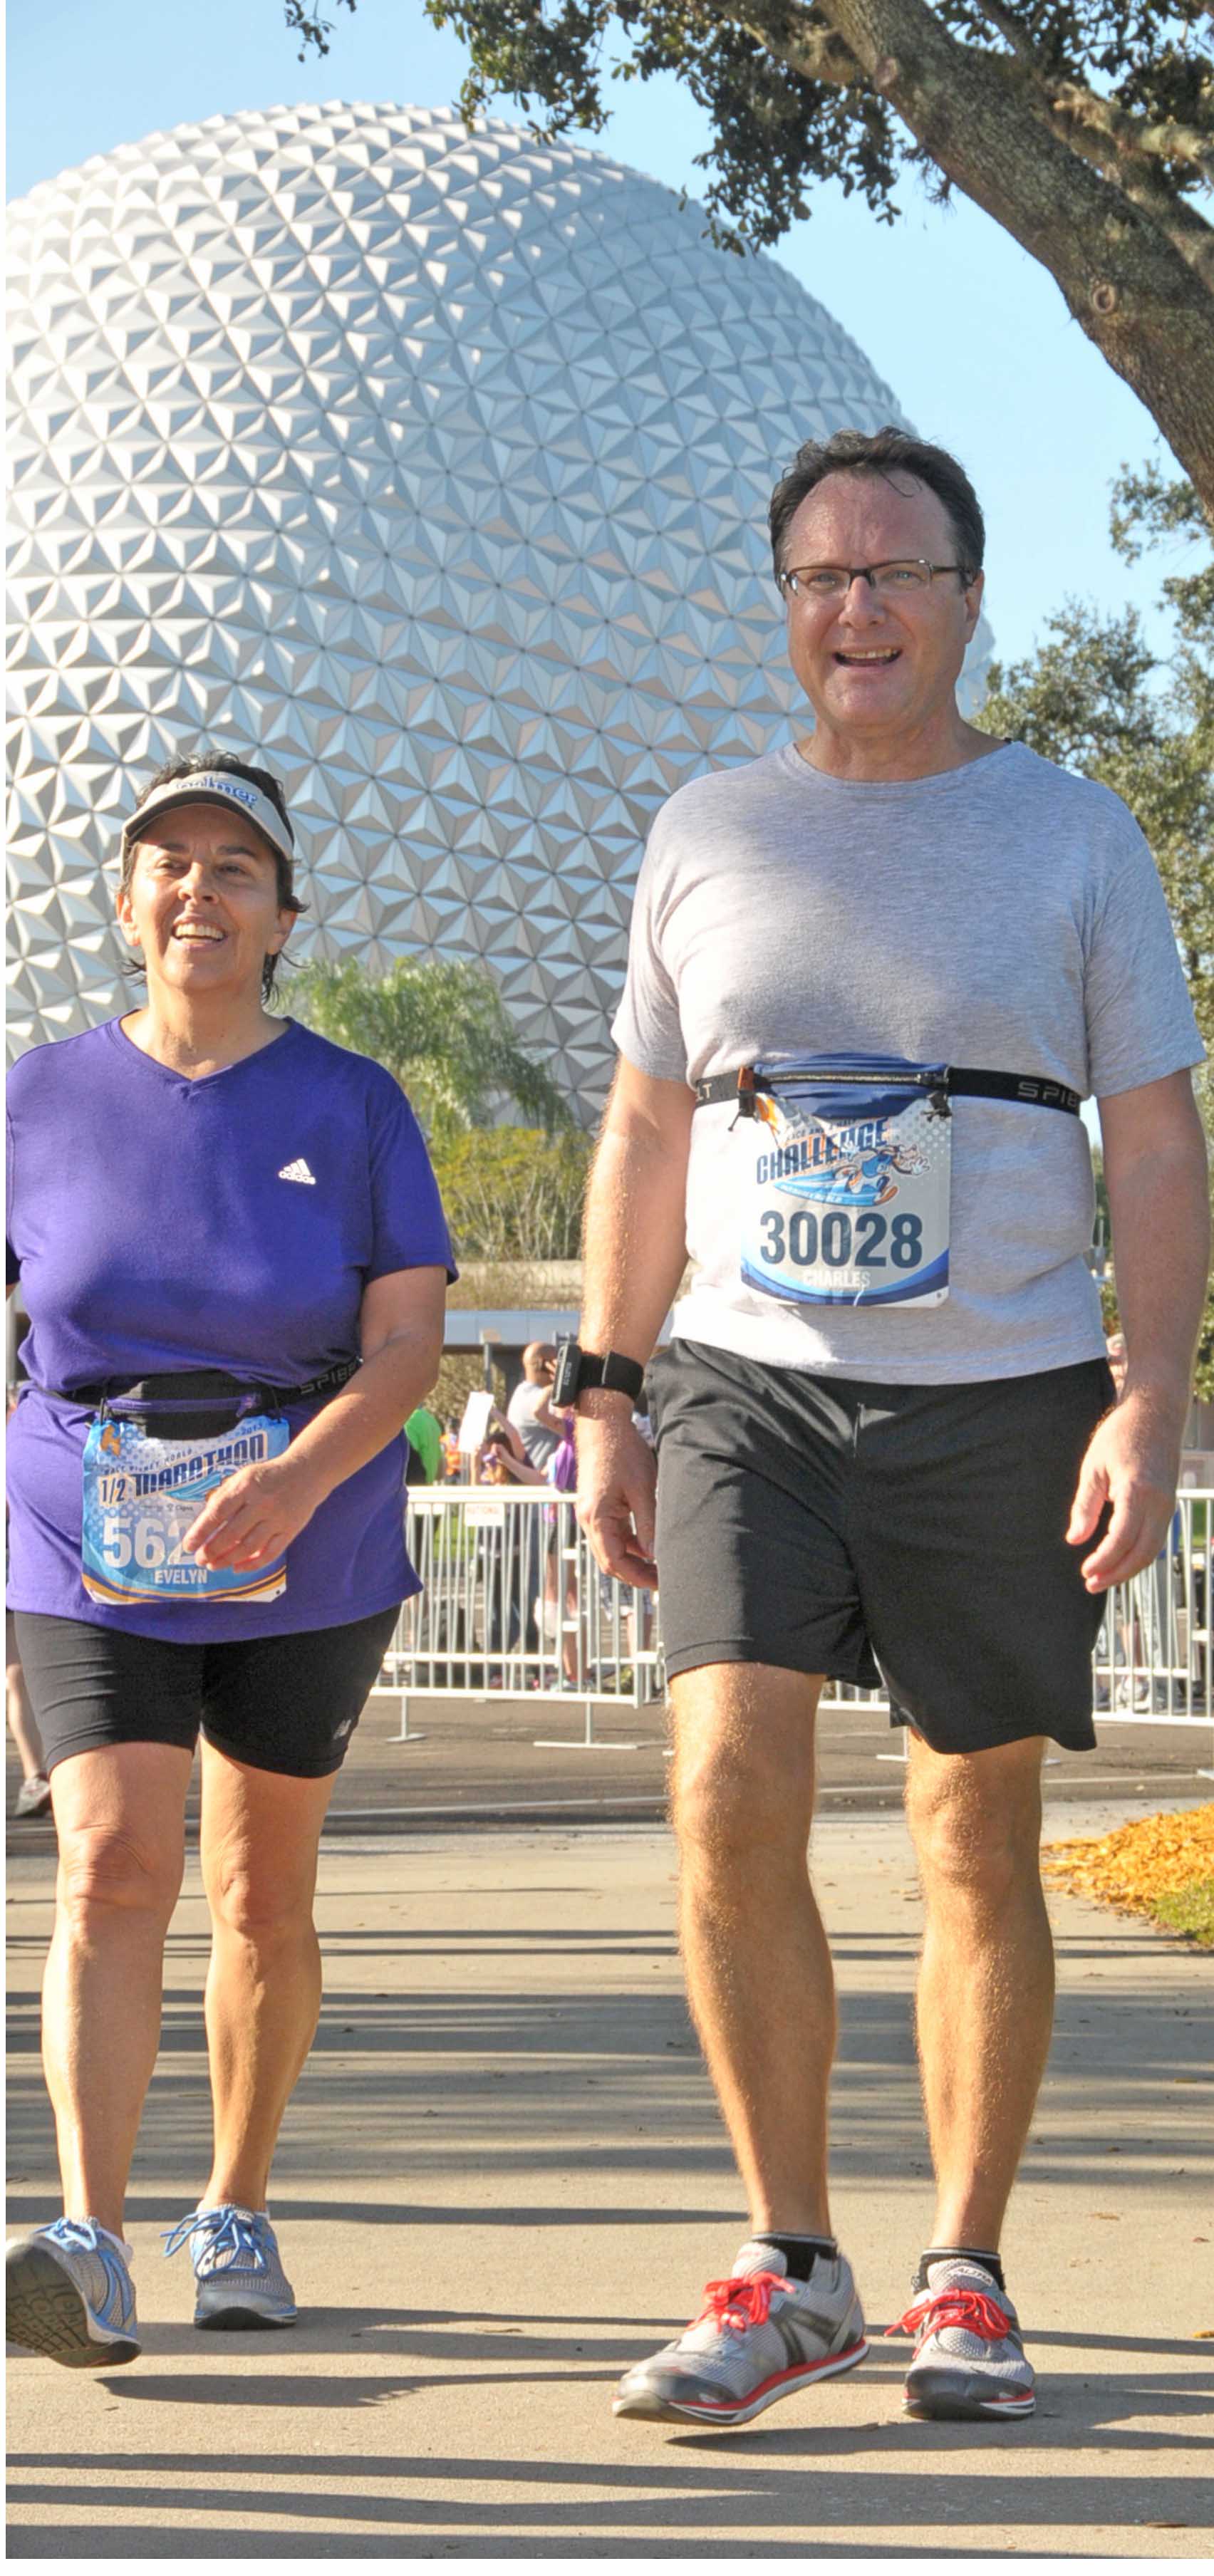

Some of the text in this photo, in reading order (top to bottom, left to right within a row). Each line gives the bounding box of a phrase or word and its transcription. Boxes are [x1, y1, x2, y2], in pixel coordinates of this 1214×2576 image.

[757, 1117, 889, 1185] CHALLENGE
[279, 1170, 316, 1185] adidas
[759, 1210, 923, 1269] 30028
[803, 1269, 871, 1288] CHARLES
[101, 1433, 264, 1504] 1/2 MARATHON
[154, 1569, 208, 1585] EVELYN
